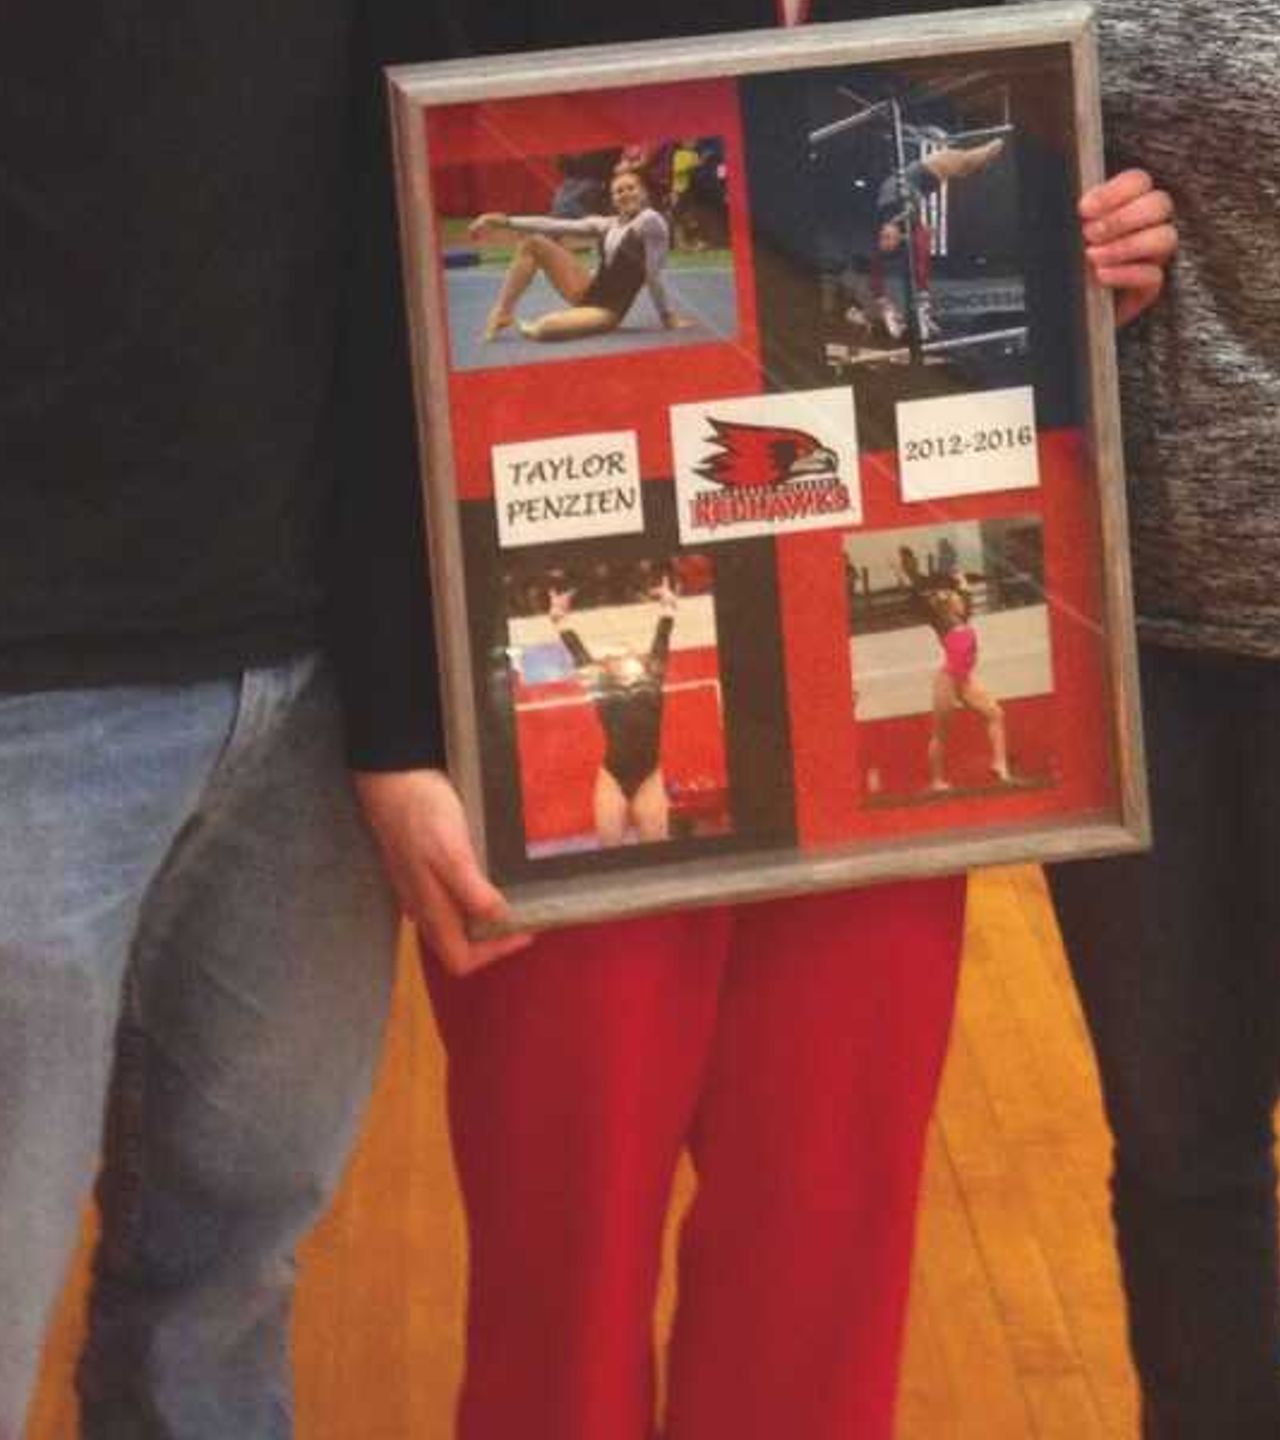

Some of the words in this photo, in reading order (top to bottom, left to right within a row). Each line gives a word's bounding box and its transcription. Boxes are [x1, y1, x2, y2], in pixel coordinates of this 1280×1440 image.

[905, 425, 1034, 462] 2012-2016
[507, 451, 627, 486] TAYLOR
[506, 487, 636, 526] PENZIEN
